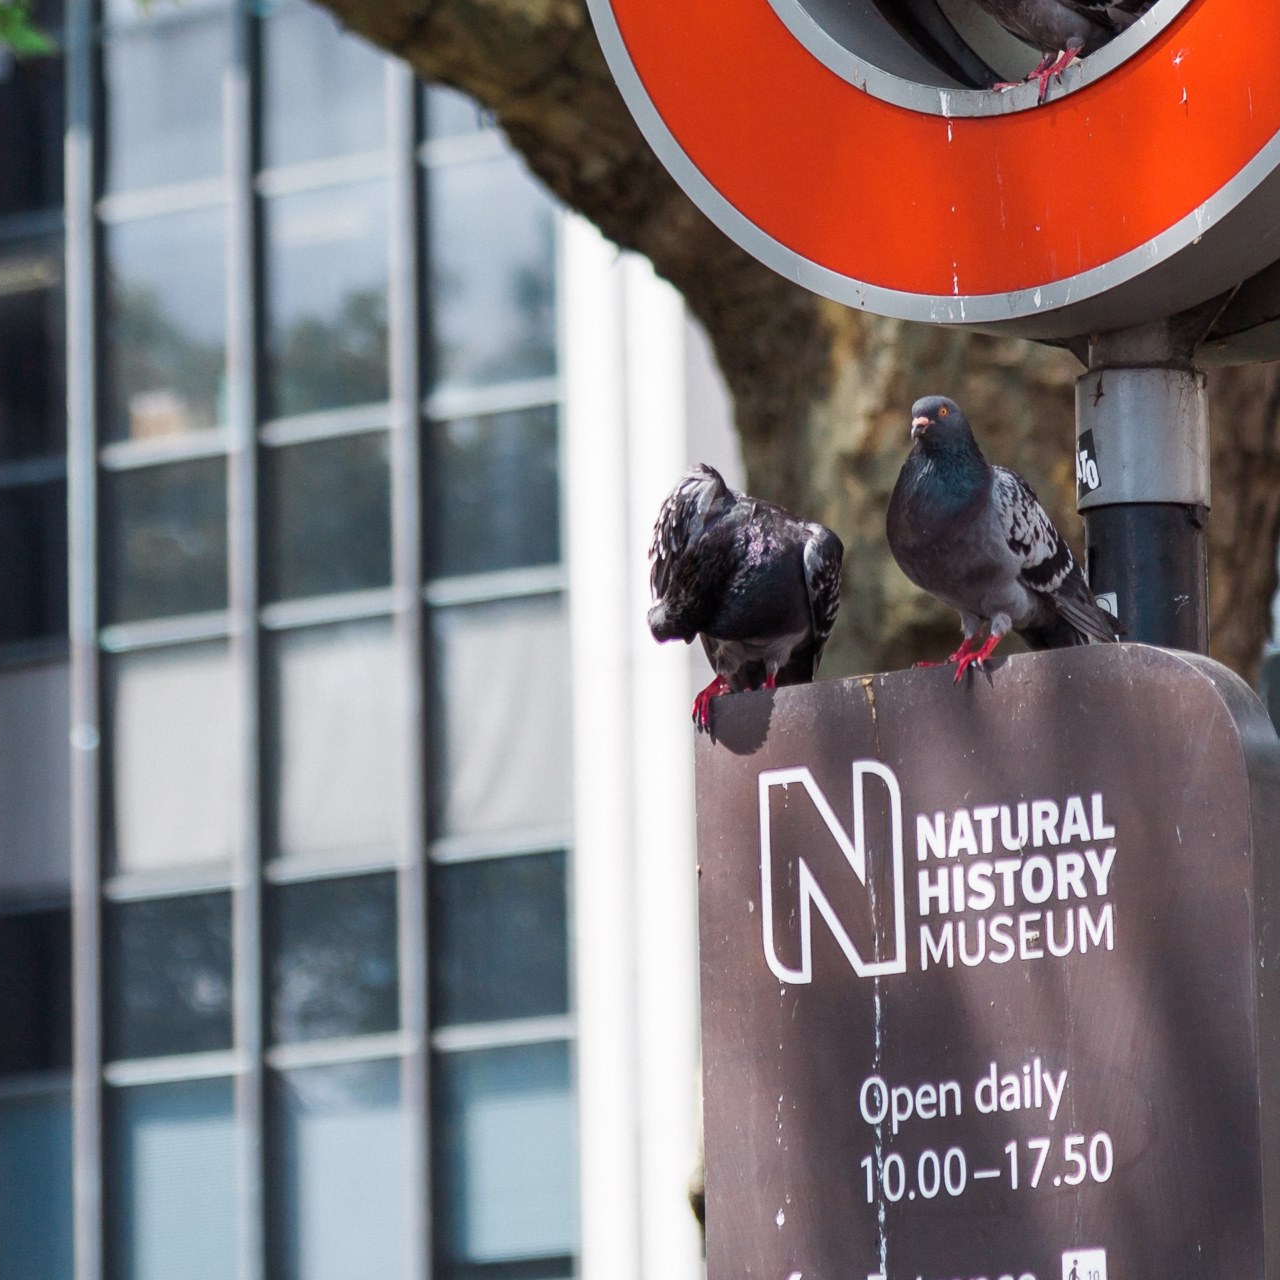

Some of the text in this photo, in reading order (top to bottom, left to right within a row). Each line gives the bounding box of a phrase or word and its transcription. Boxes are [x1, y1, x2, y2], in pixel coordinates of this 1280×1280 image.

[916, 793, 1116, 862] NATURAL
[918, 847, 1117, 916] HISTORY
[919, 903, 1115, 971] MUSEUM
[859, 1056, 1068, 1135] Open daily
